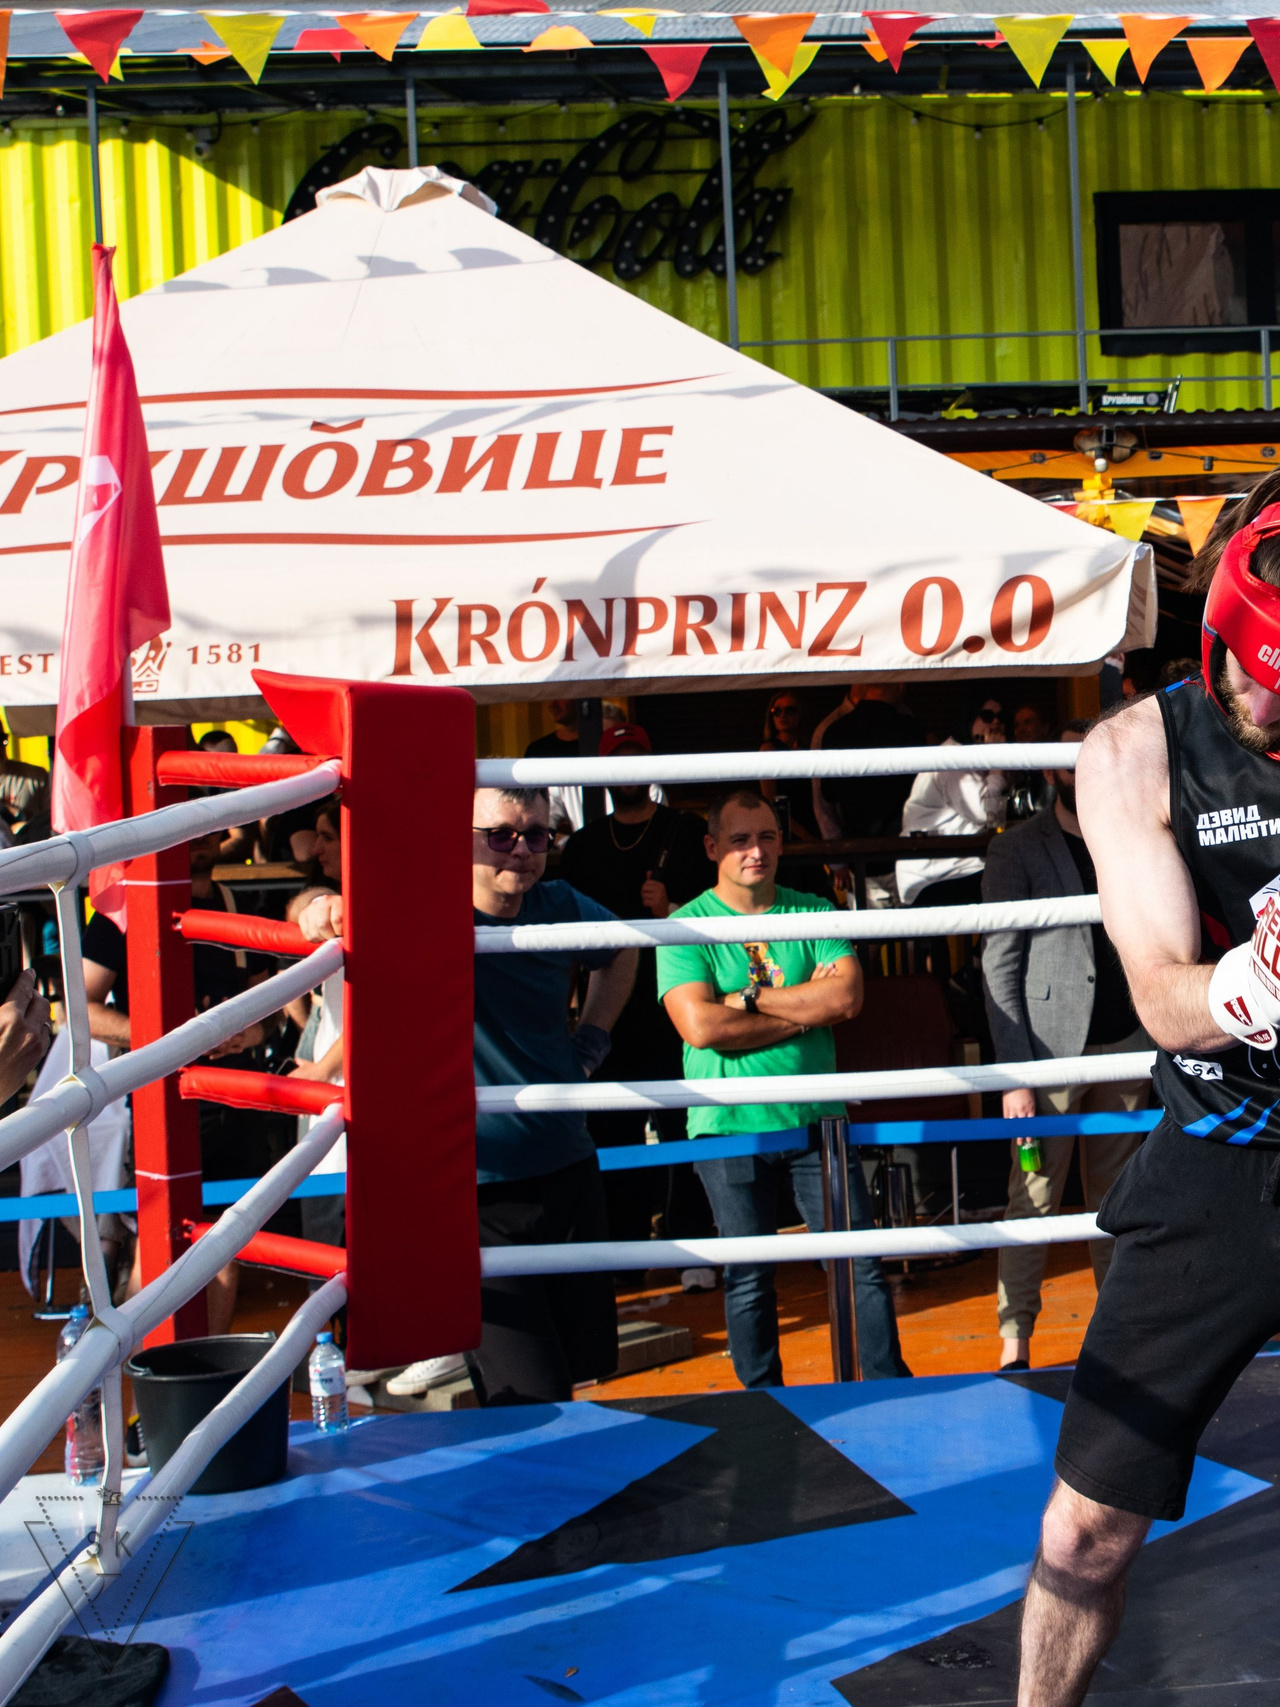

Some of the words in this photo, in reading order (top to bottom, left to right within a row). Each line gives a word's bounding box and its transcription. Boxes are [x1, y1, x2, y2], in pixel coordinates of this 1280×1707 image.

[0, 417, 673, 515] РШО̌ВИЦЕ
[186, 643, 261, 666] 1581
[388, 577, 867, 677] KRÓNPRINZ
[899, 574, 1055, 657] 0.0
[1196, 804, 1261, 830] ДЭВИД
